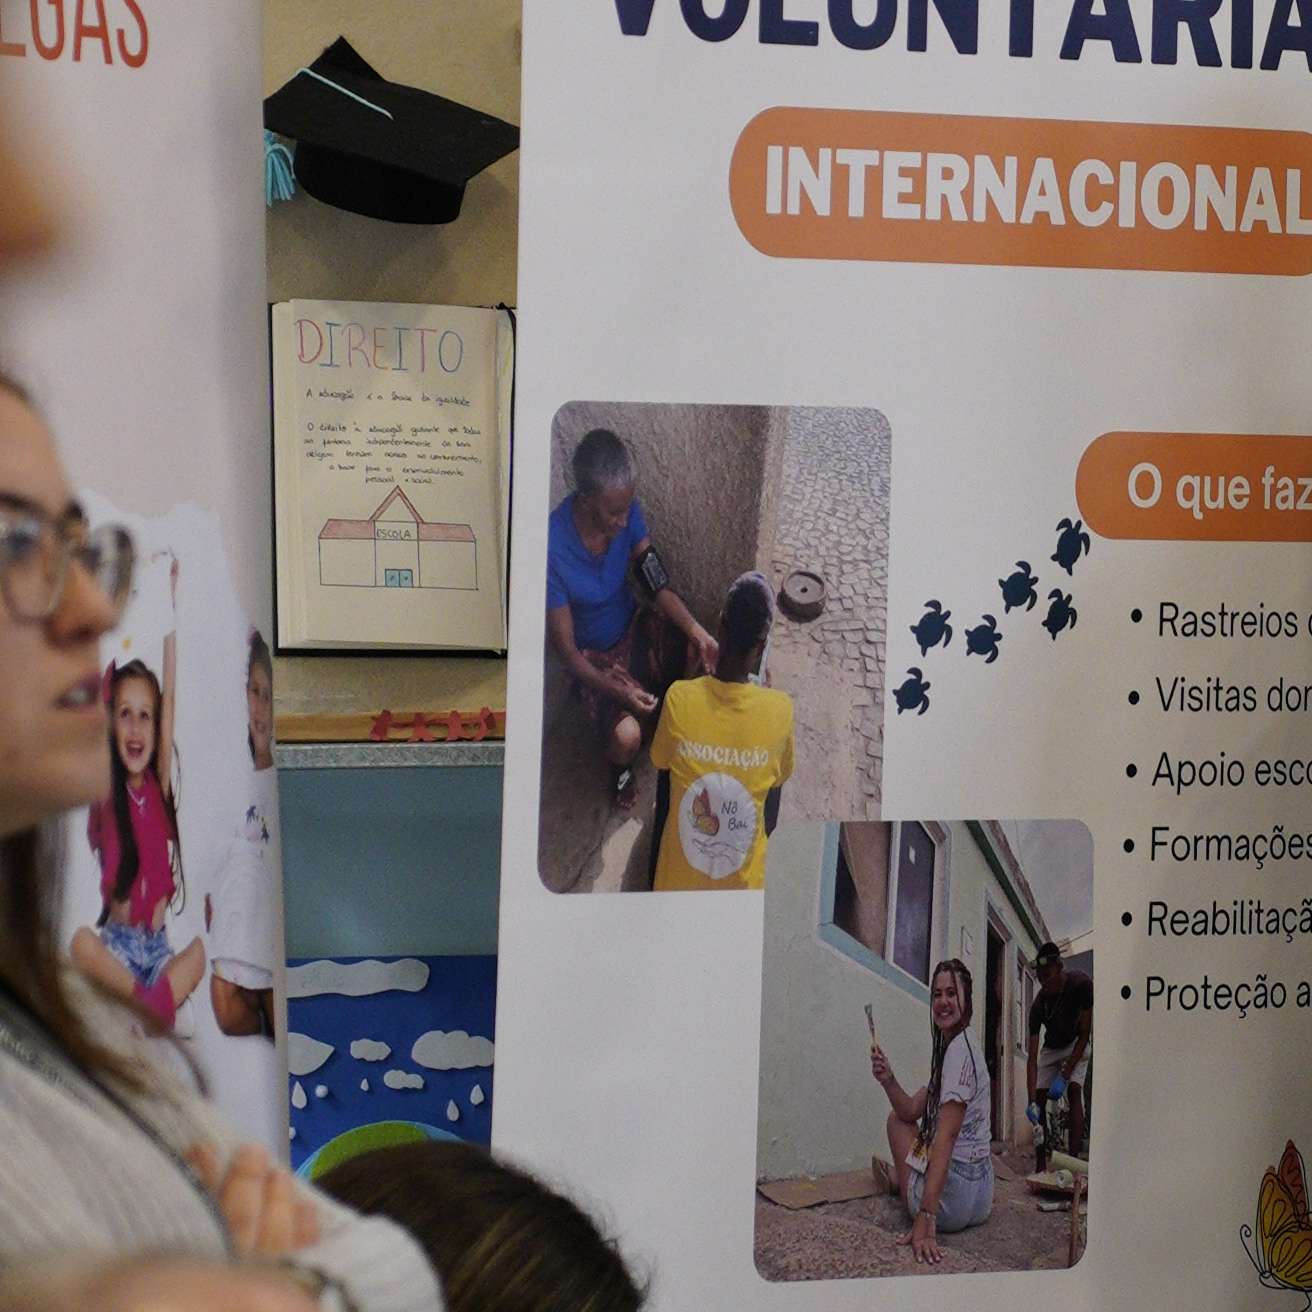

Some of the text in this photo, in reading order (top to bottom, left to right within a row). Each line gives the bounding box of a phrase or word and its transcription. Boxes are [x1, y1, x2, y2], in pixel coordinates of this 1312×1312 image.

[295, 318, 463, 374] DIREITO
[1126, 462, 1163, 509] O
[1175, 472, 1250, 519] que
[1158, 602, 1299, 639] Rastreios
[1155, 676, 1257, 713] Visitas
[1151, 751, 1245, 795] Apoio
[1144, 975, 1287, 1019] Proteção
